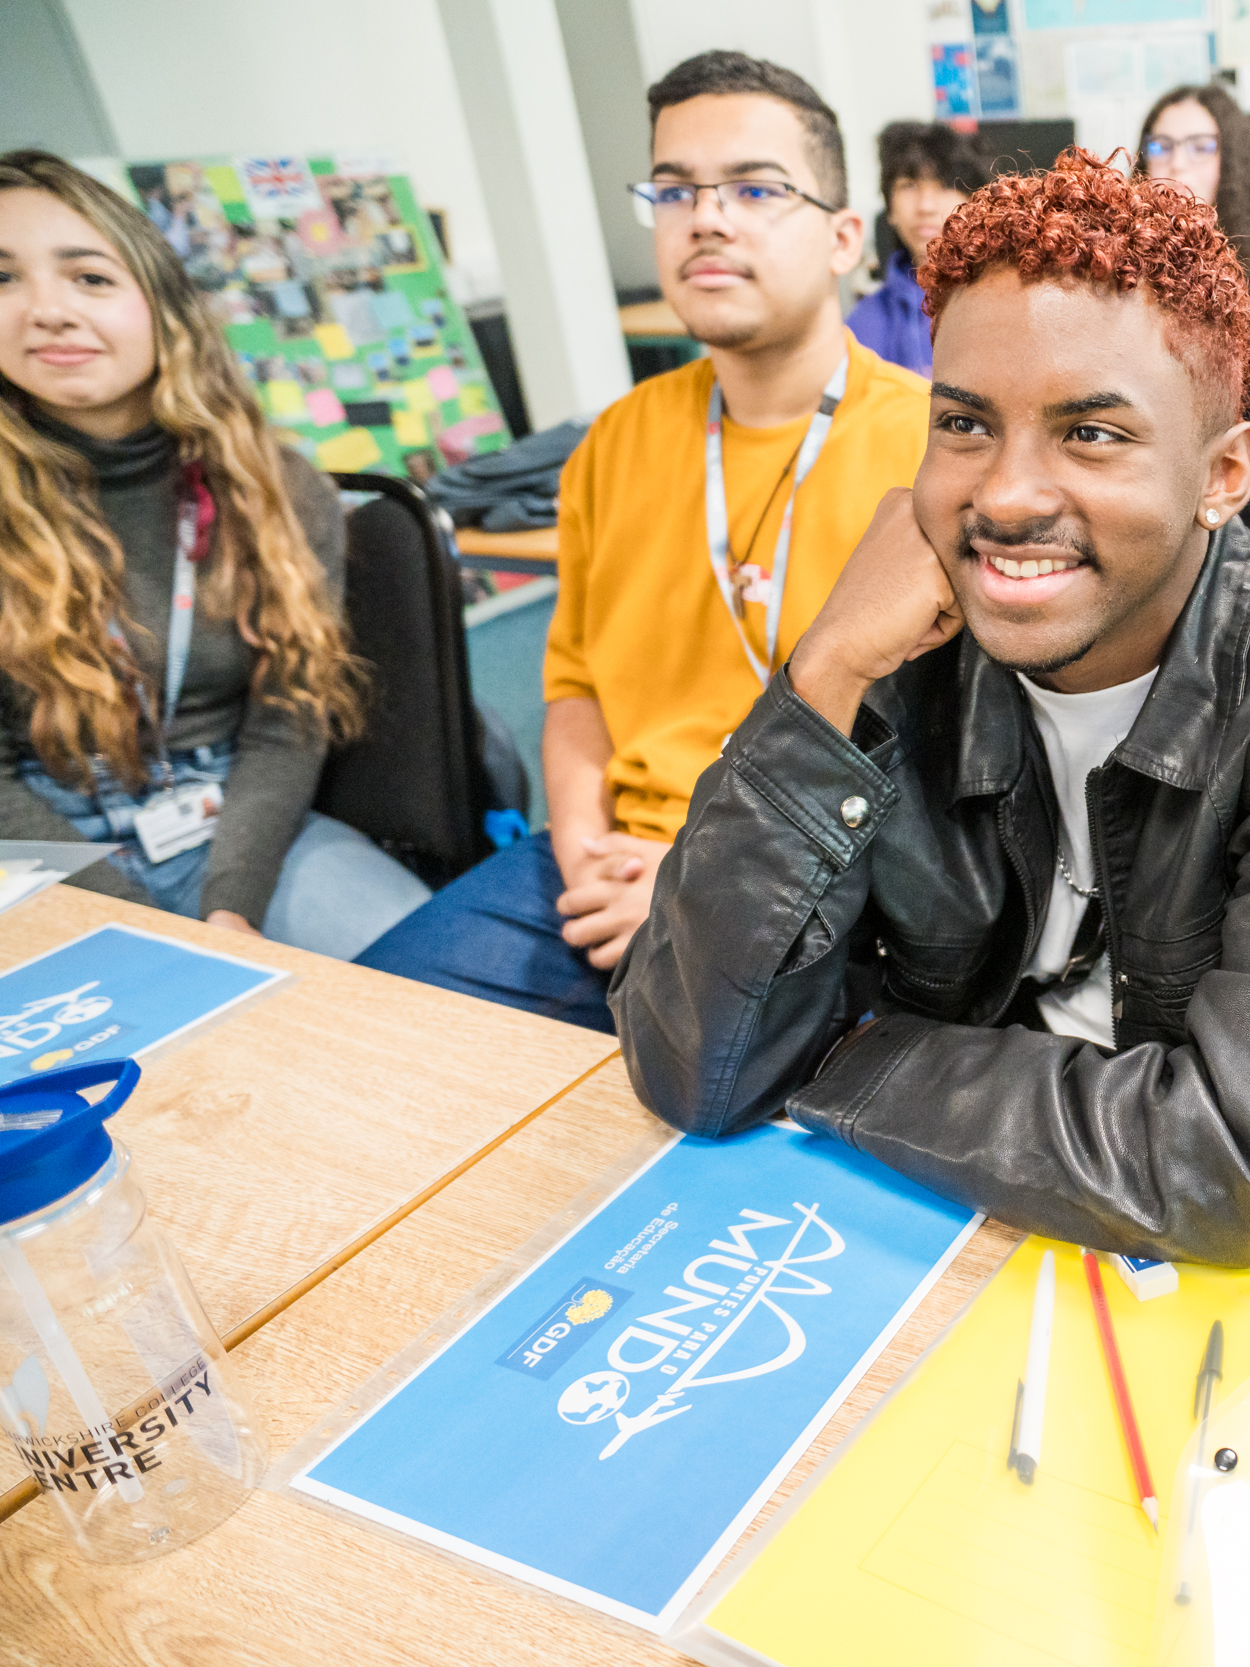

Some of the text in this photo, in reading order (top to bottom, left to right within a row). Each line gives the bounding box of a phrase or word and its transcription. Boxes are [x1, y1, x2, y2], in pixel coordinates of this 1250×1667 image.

[604, 1203, 678, 1270] de Educação
[616, 1221, 679, 1274] Secretaria
[523, 1323, 571, 1368] GDF
[660, 1266, 769, 1376] PONTES PARA O
[135, 1357, 206, 1418] COLLEGE
